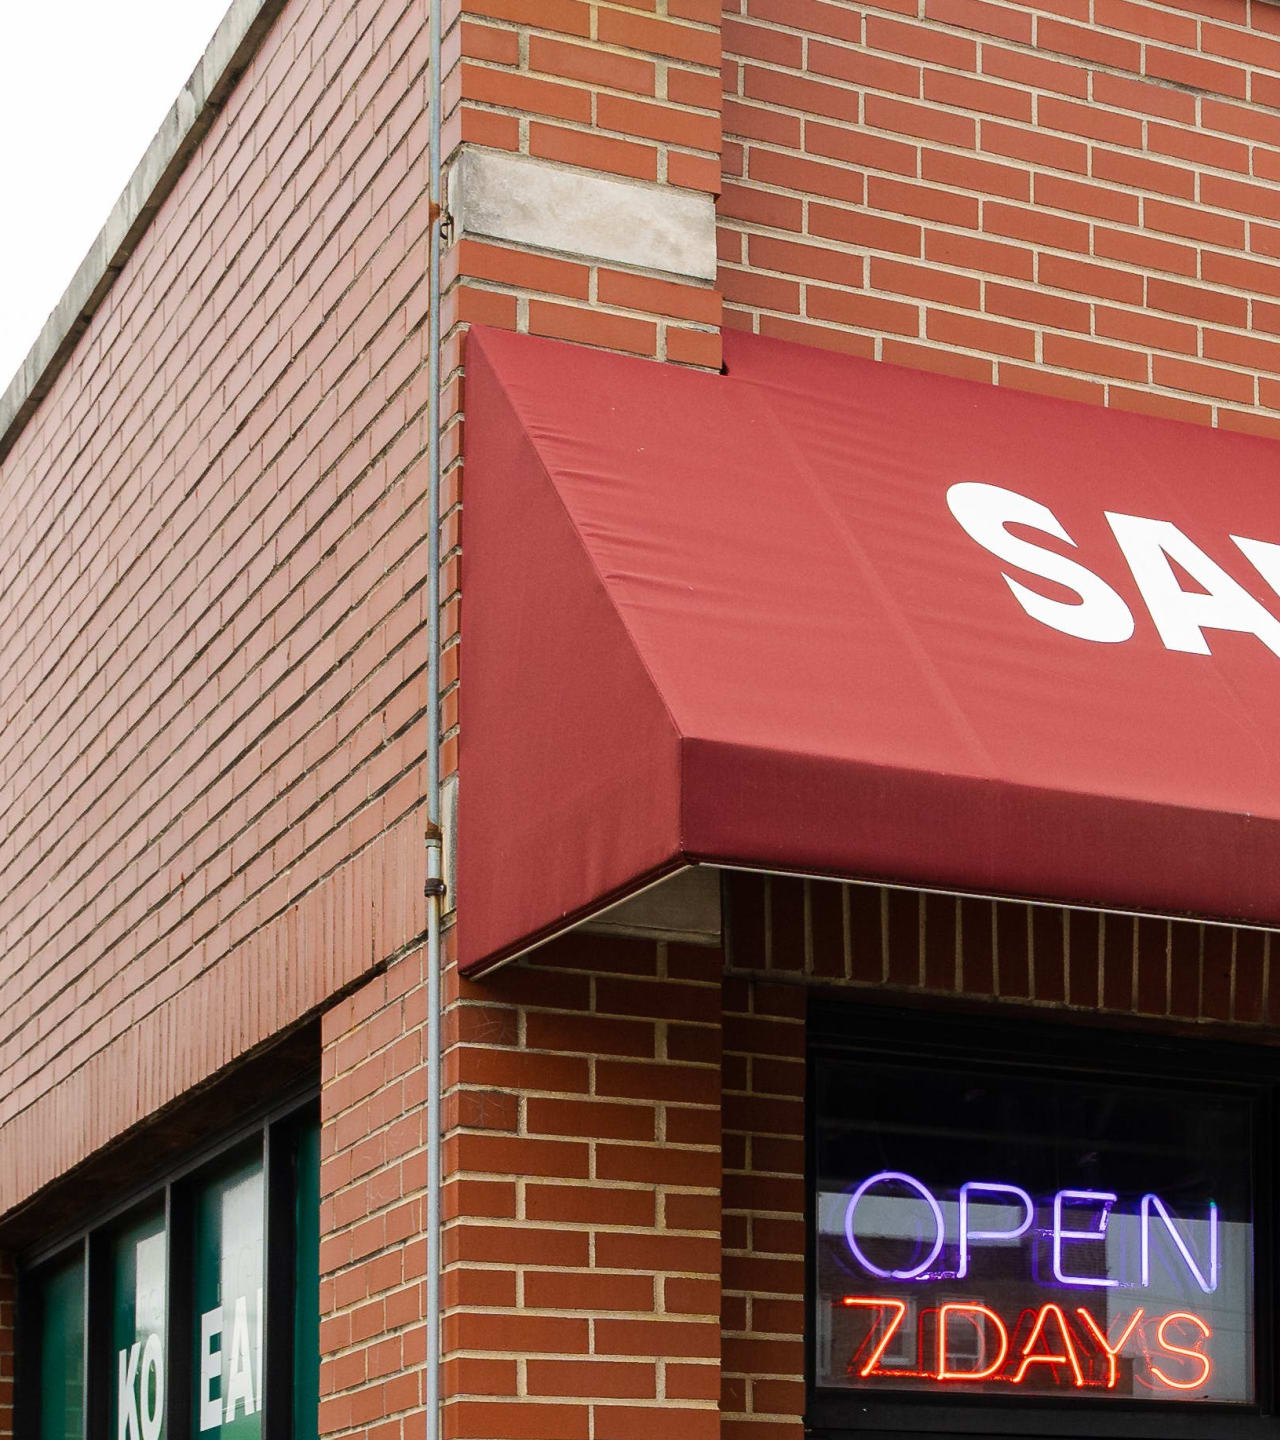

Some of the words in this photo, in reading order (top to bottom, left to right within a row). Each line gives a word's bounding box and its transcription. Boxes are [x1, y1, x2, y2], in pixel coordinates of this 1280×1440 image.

[845, 1171, 1217, 1294] OPEN
[844, 1297, 905, 1377] 7
[937, 1302, 1212, 1389] DAYS
